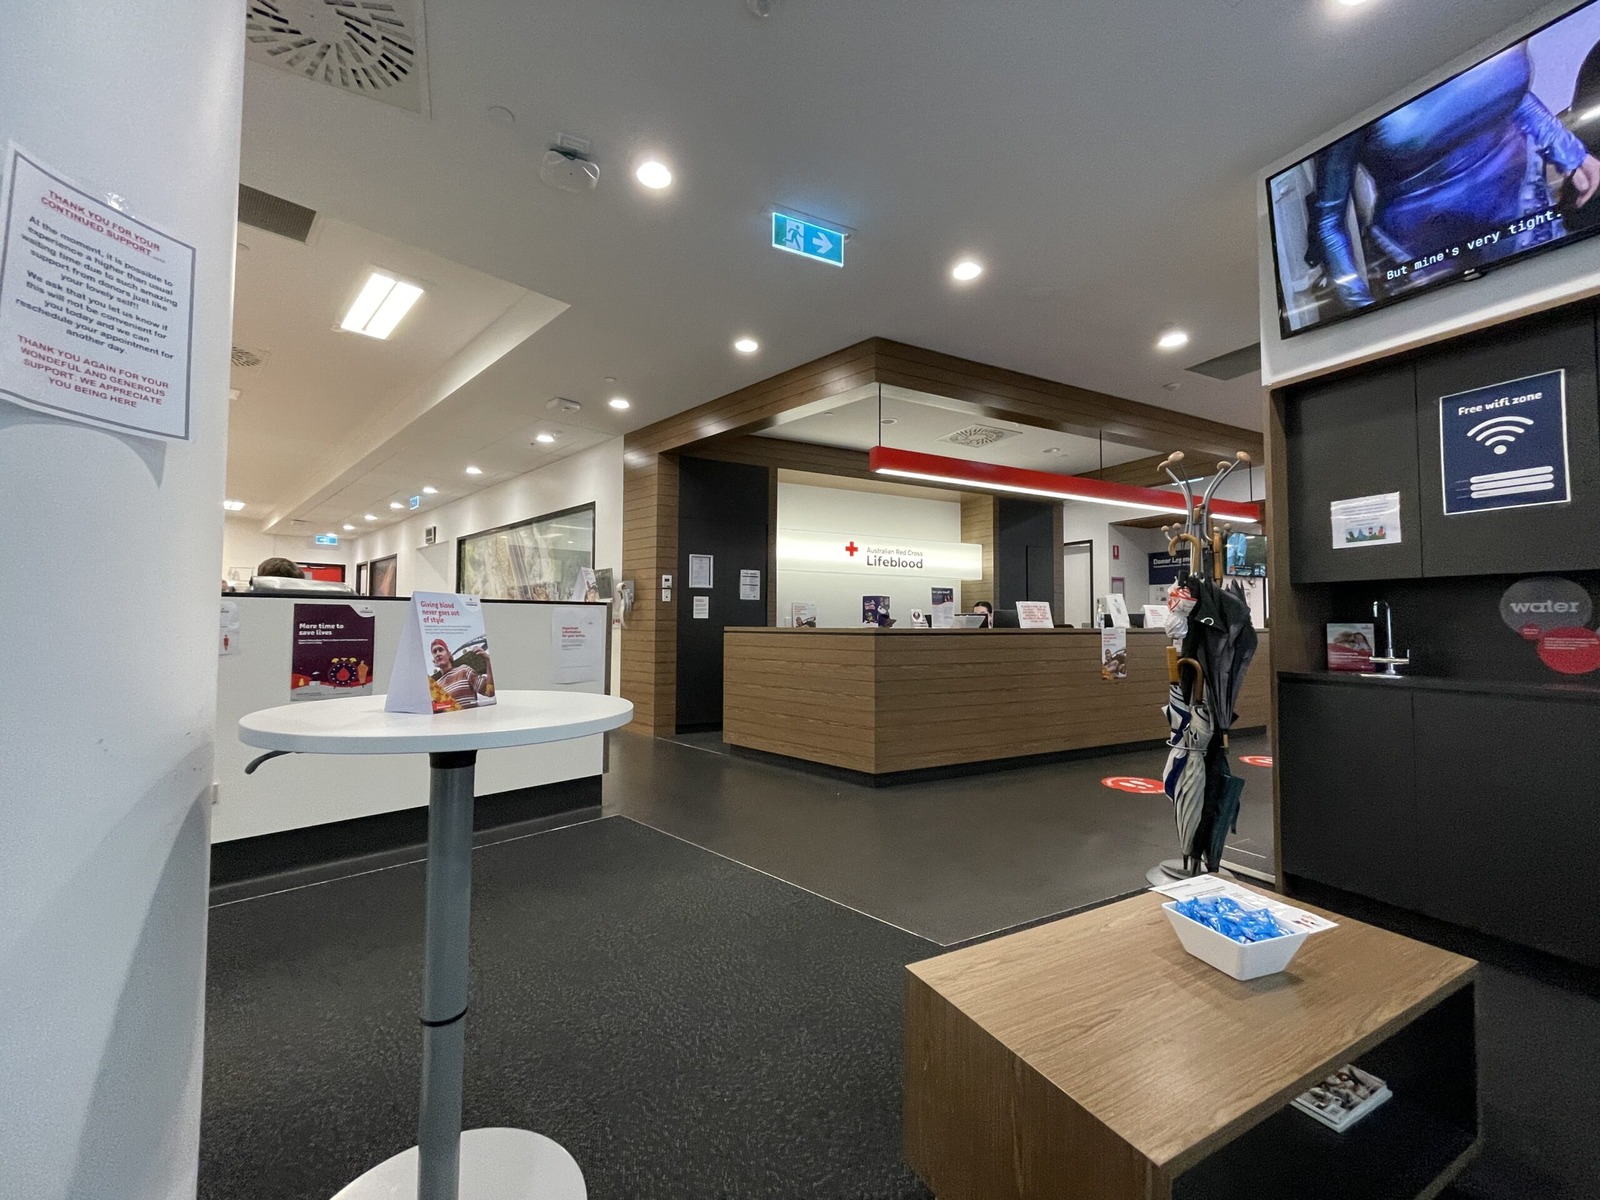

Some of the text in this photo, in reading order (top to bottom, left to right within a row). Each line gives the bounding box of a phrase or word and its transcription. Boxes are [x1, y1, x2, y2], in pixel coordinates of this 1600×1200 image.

[41, 197, 104, 233] CONTINUED
[49, 190, 160, 251] THANK YOU FOR YOUR
[28, 227, 83, 257] experience
[95, 257, 124, 275] higher
[127, 272, 147, 285] than
[149, 282, 173, 295] usual
[29, 216, 40, 227] At
[42, 223, 58, 235] the
[106, 253, 113, 261] it
[115, 257, 122, 265] is
[125, 263, 162, 282] possible
[164, 279, 173, 287] to
[1386, 210, 1562, 280] But mine's very tight.
[21, 233, 178, 307] waiting time due to such amazing
[30, 250, 168, 311] support from donors just like
[61, 273, 84, 287] your
[86, 283, 114, 300] lovely
[26, 281, 167, 339] this will not be convenient for
[27, 270, 43, 282] We
[45, 280, 63, 291] ask
[66, 287, 86, 301] that
[88, 297, 106, 308] you
[108, 304, 120, 314] let
[122, 311, 134, 319] us
[135, 315, 160, 328] know
[15, 298, 174, 359] reschedule your appointment for
[44, 300, 150, 343] you today and we can
[66, 329, 105, 346] another
[17, 334, 169, 388] THANK YOU AGAIN FOR YOUR
[20, 346, 166, 397] WONDEFUL AND GENEROUS
[49, 377, 137, 408] YOU BEING HERE
[80, 376, 97, 387] WE
[99, 383, 162, 405] APPRECIATE
[1458, 392, 1543, 416] Free wifi zone
[866, 547, 894, 555] Australian
[866, 555, 923, 569] Lifeblood
[1153, 557, 1171, 565] Donor
[420, 601, 439, 609] Giving
[1510, 599, 1580, 614] water
